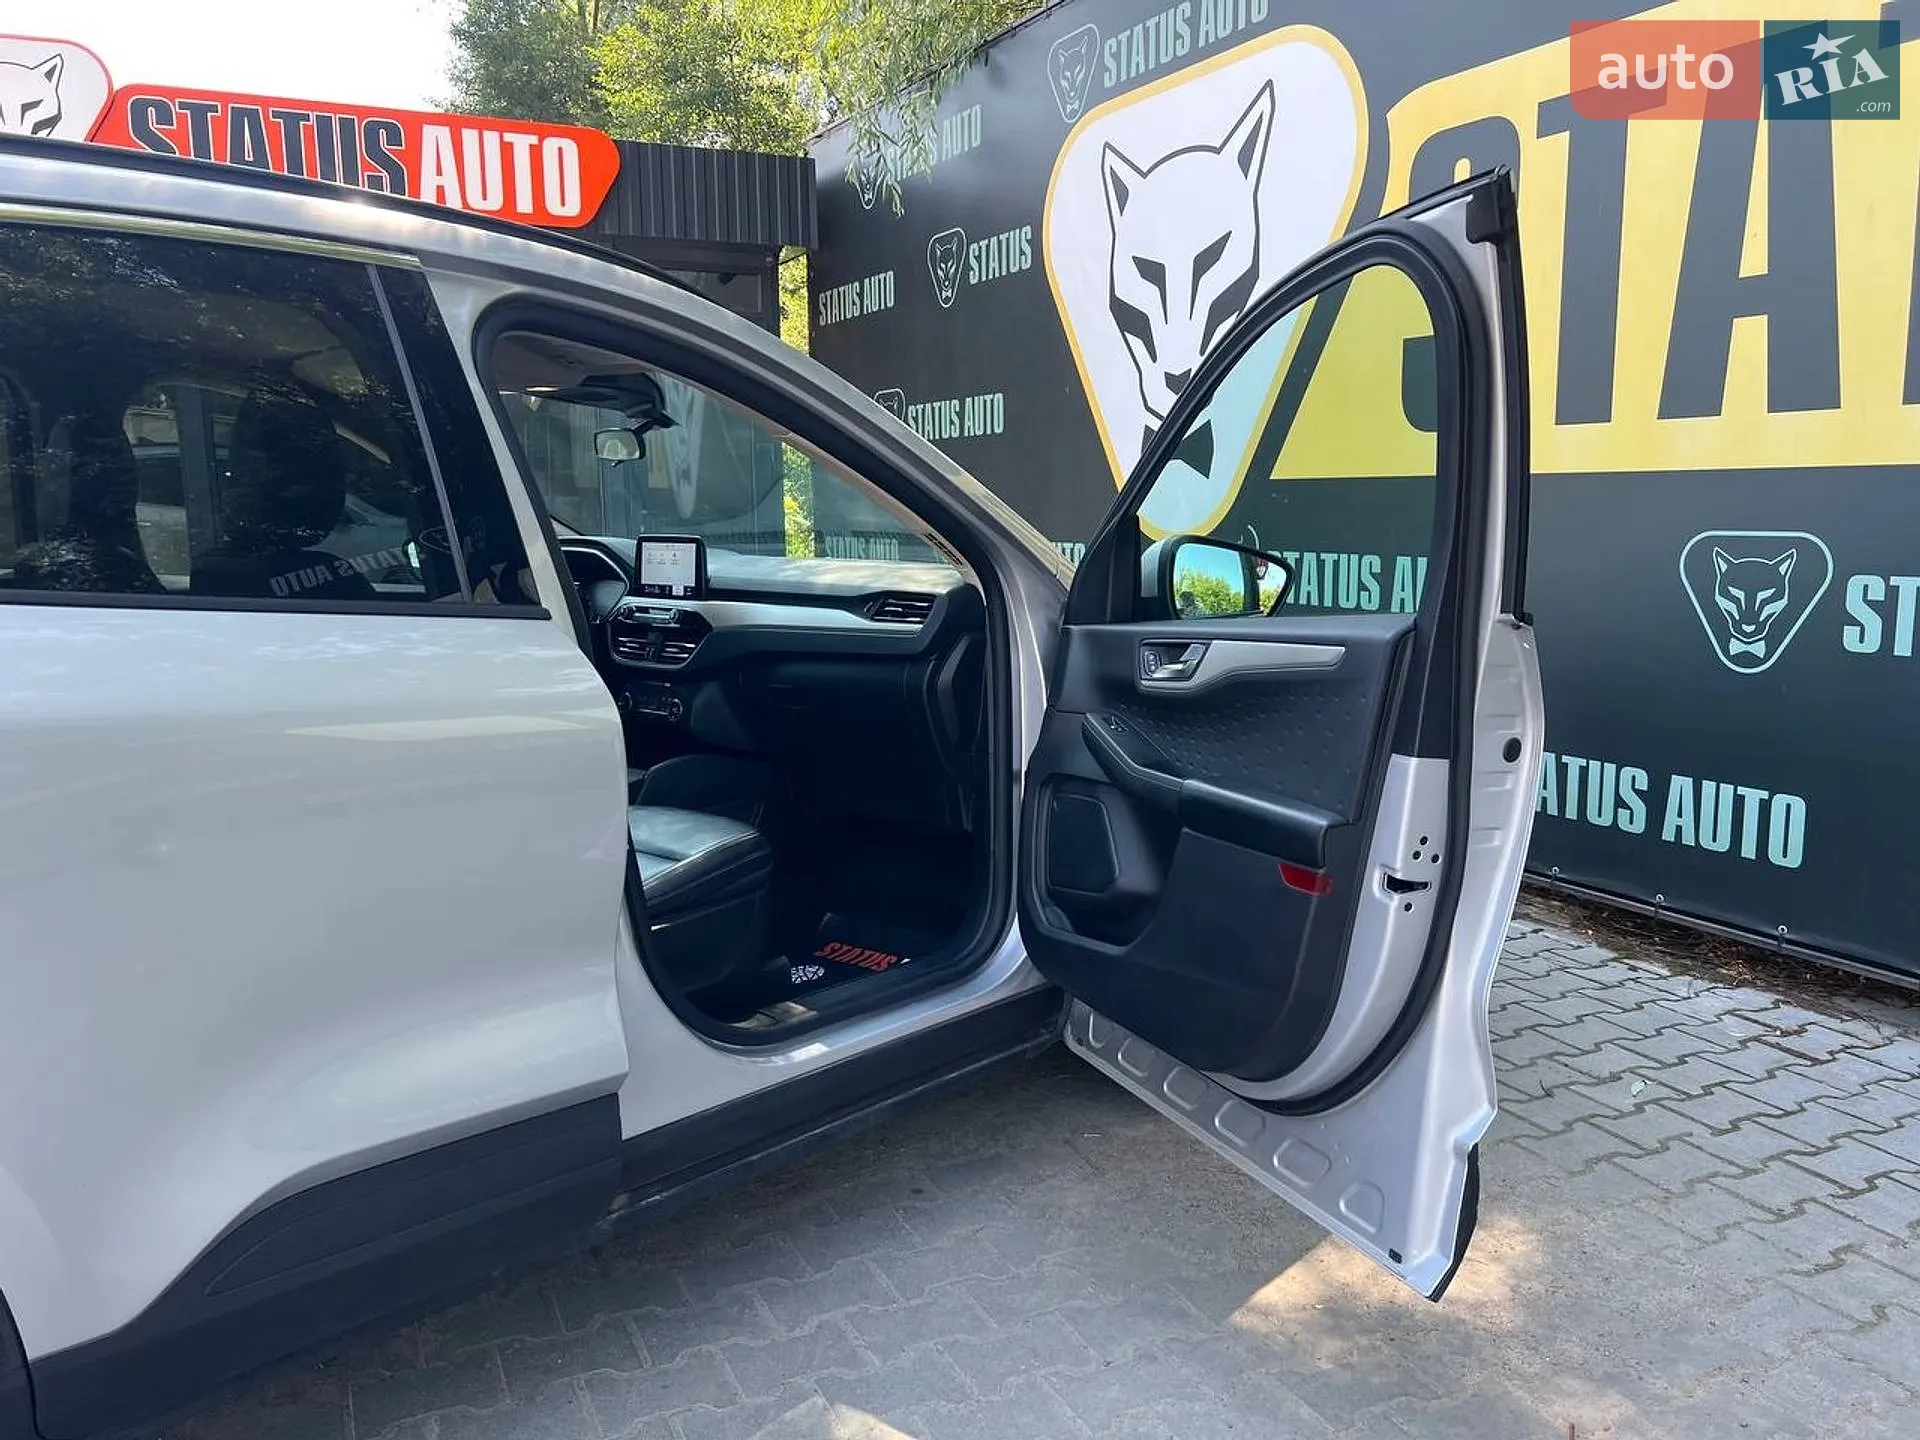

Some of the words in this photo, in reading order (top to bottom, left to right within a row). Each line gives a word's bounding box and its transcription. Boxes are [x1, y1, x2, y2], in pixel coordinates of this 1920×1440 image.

[1104, 1, 1191, 88] STATUS
[128, 95, 408, 200] STATUS
[419, 124, 581, 218] AUTO
[942, 103, 981, 163] AUTO
[968, 225, 1032, 285] STATUS
[819, 280, 860, 327] STATUS
[863, 270, 894, 315] AUTO
[907, 399, 960, 440] STATUS
[964, 392, 1004, 437] AUTO
[1267, 551, 1382, 611] TATUS
[1661, 774, 1807, 869] AUTO
